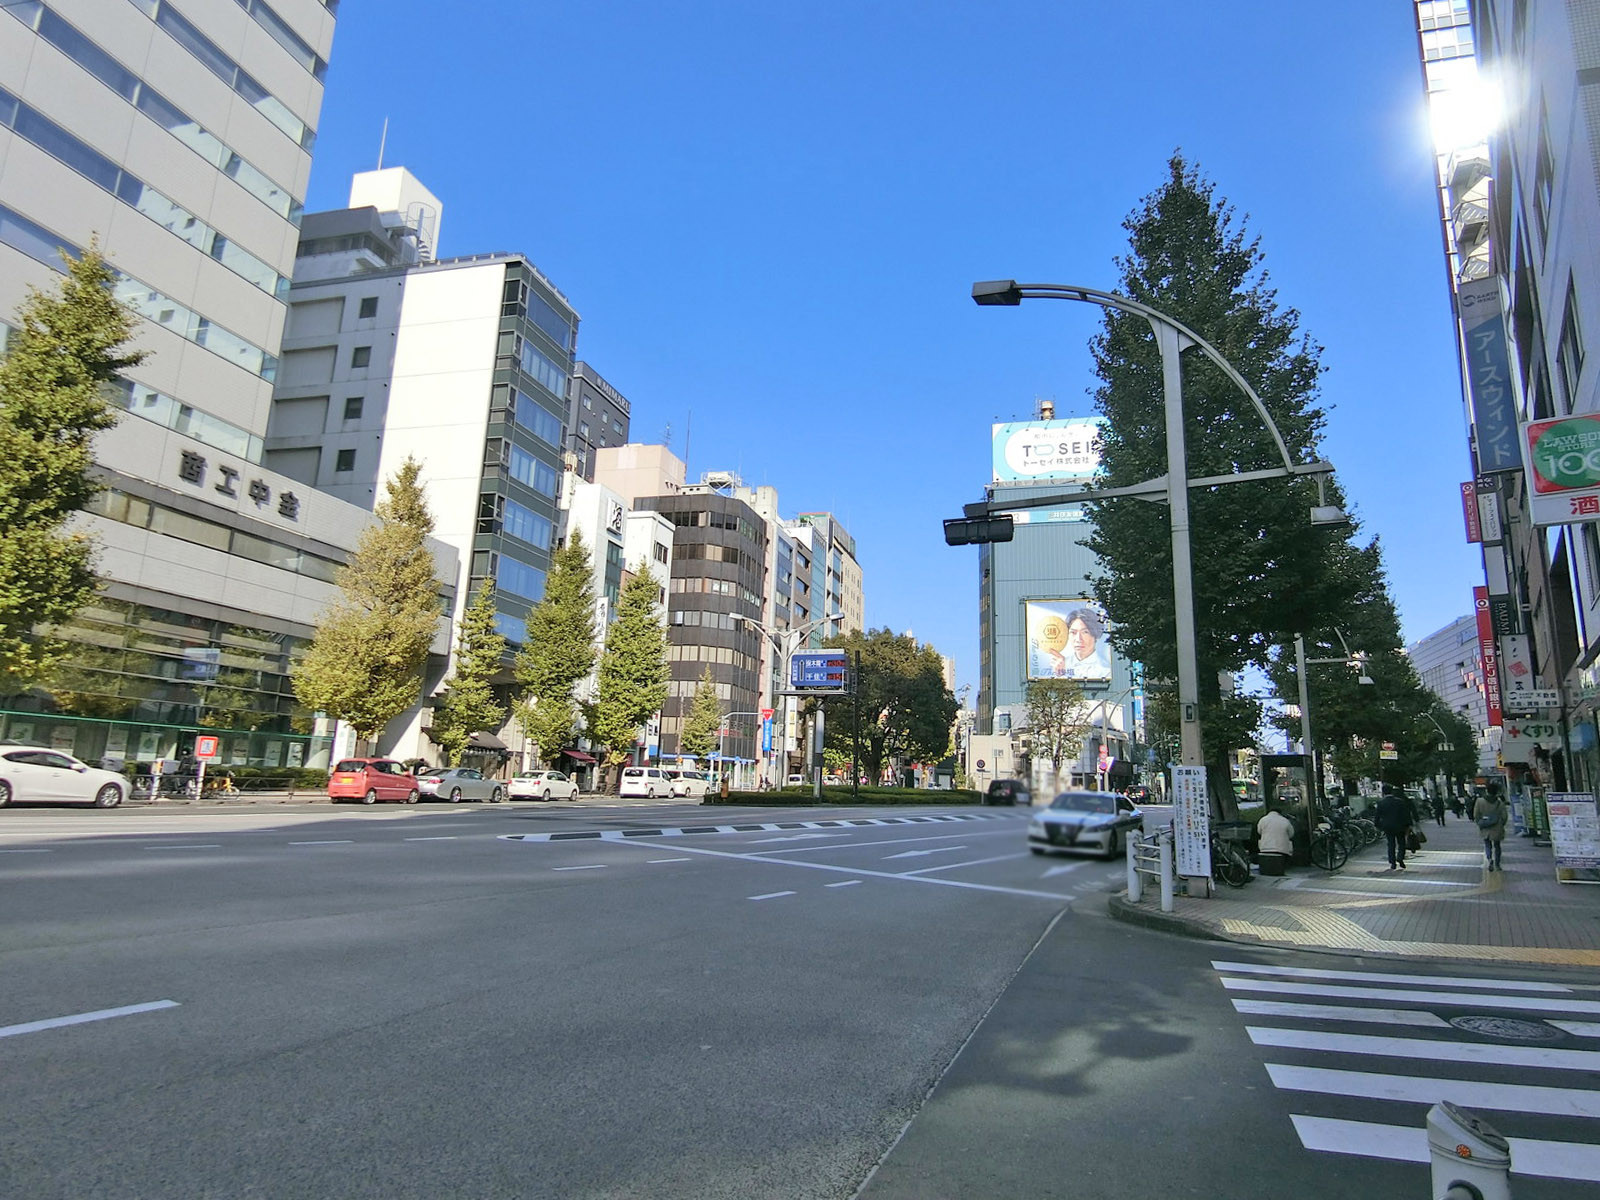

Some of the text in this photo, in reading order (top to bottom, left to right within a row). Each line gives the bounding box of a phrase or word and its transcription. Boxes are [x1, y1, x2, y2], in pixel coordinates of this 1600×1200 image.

[601, 381, 631, 412] MIMARU
[1474, 330, 1511, 466] アースウィンド
[1022, 441, 1090, 457] TOSEI
[1557, 441, 1596, 452] STORE
[1023, 457, 1090, 467] トーセイ株式会社
[179, 449, 301, 523] 商工中金
[1522, 724, 1554, 738] くすり
